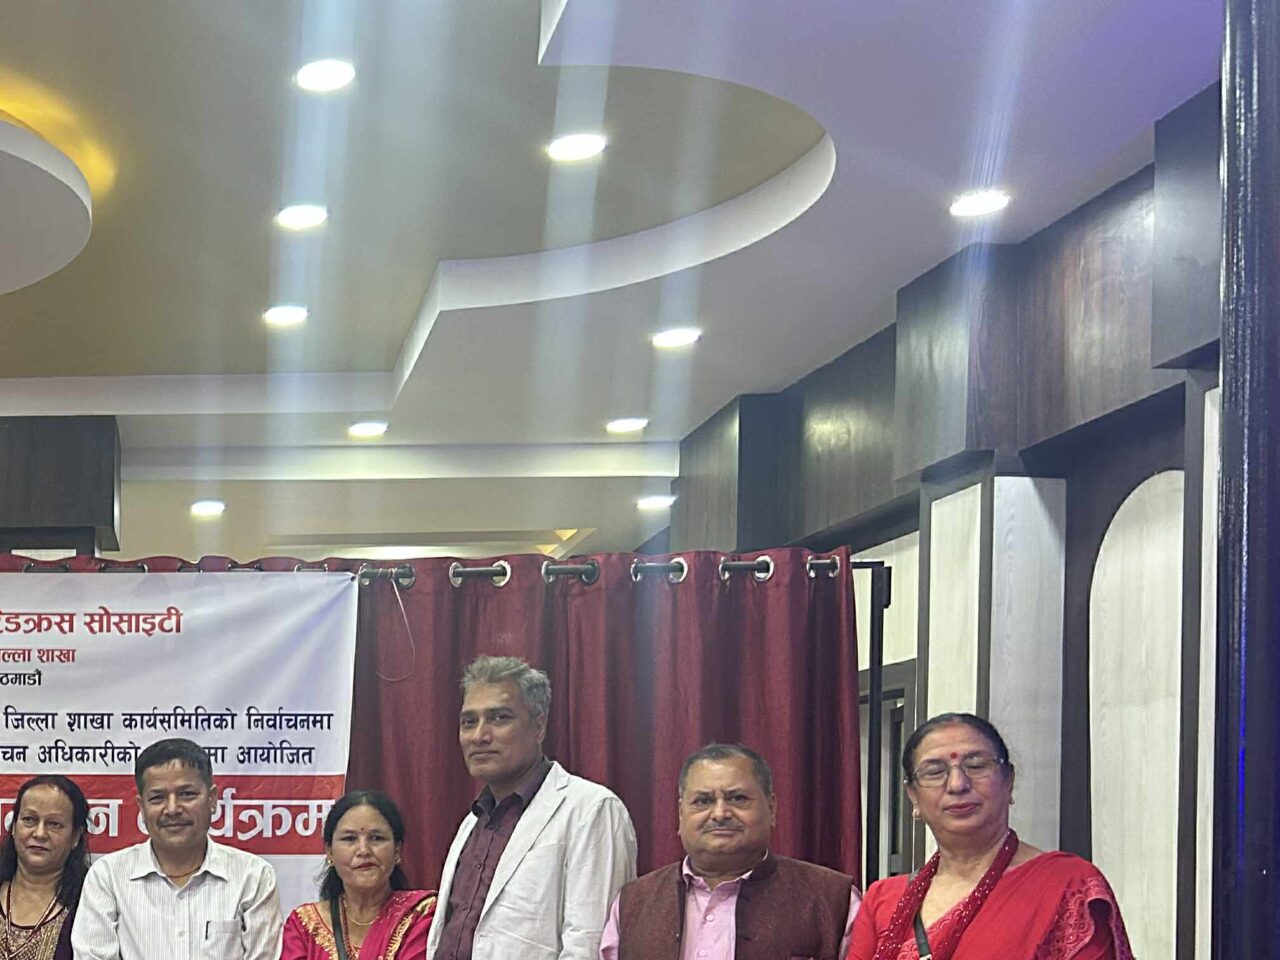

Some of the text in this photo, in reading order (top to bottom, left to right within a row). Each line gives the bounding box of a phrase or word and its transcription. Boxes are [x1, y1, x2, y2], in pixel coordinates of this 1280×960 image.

[83, 606, 183, 637] सोसाइटी
[37, 648, 77, 663] शाखा
[3, 705, 58, 732] जिल्ला
[66, 712, 114, 733] शाखा
[121, 706, 238, 732] कार्यसमितिको
[245, 706, 334, 731] निर्वाचनमा
[37, 739, 140, 767] अधिकारीको
[236, 740, 315, 764] आयोजित
